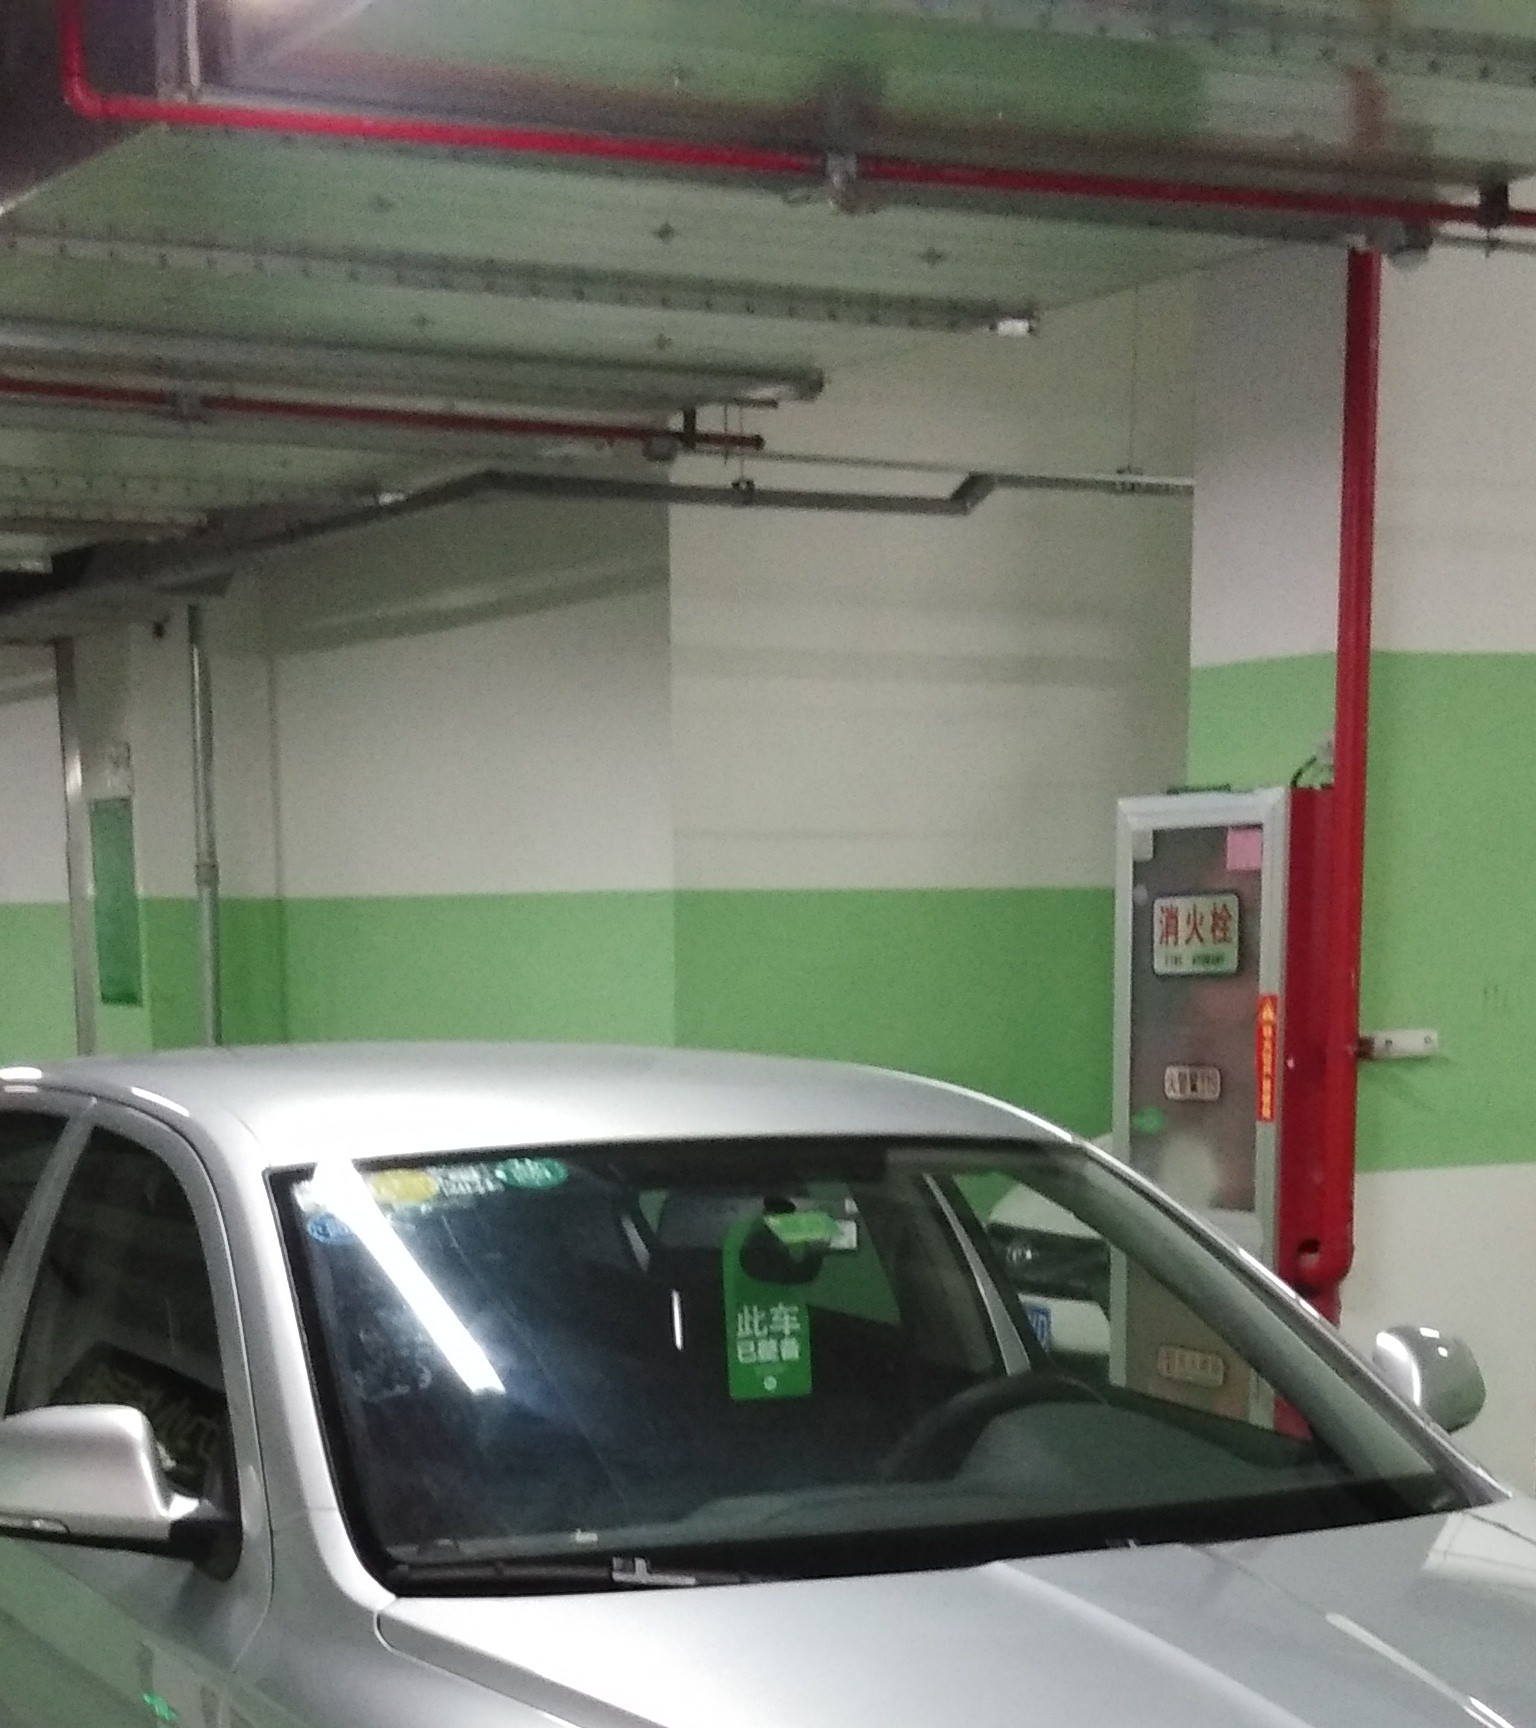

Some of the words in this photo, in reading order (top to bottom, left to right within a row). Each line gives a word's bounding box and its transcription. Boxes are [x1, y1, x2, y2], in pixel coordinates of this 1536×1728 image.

[1159, 903, 1232, 946] 消火栓
[736, 1302, 801, 1338] 此车
